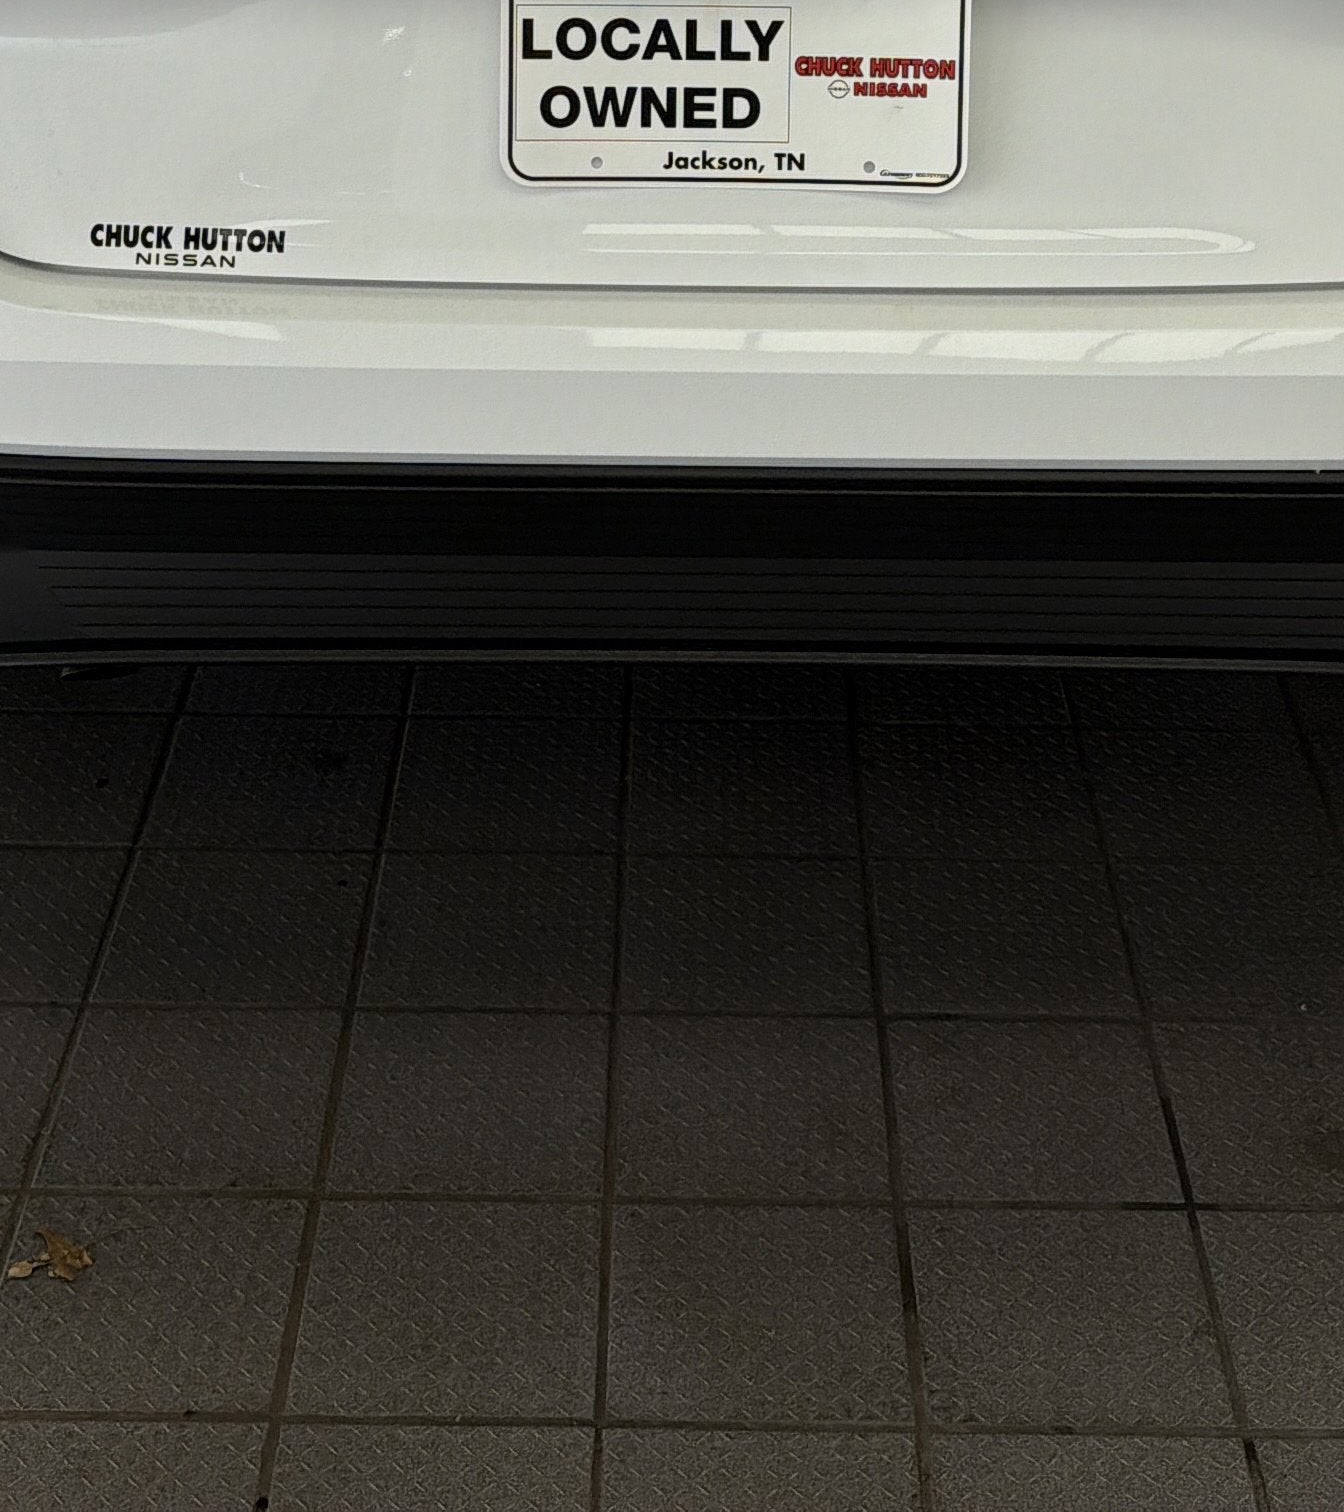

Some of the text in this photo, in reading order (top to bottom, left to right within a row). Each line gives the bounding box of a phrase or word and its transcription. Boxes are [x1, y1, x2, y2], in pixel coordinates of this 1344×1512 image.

[521, 18, 784, 62] LOCALLY
[794, 55, 956, 80] CHUCK HUTTON
[853, 81, 928, 98] NISSAN
[539, 85, 762, 129] OWNED
[662, 150, 805, 173] Jackson, TN
[90, 223, 286, 253] CHUCK HUTTON
[135, 252, 236, 268] NISSAN
